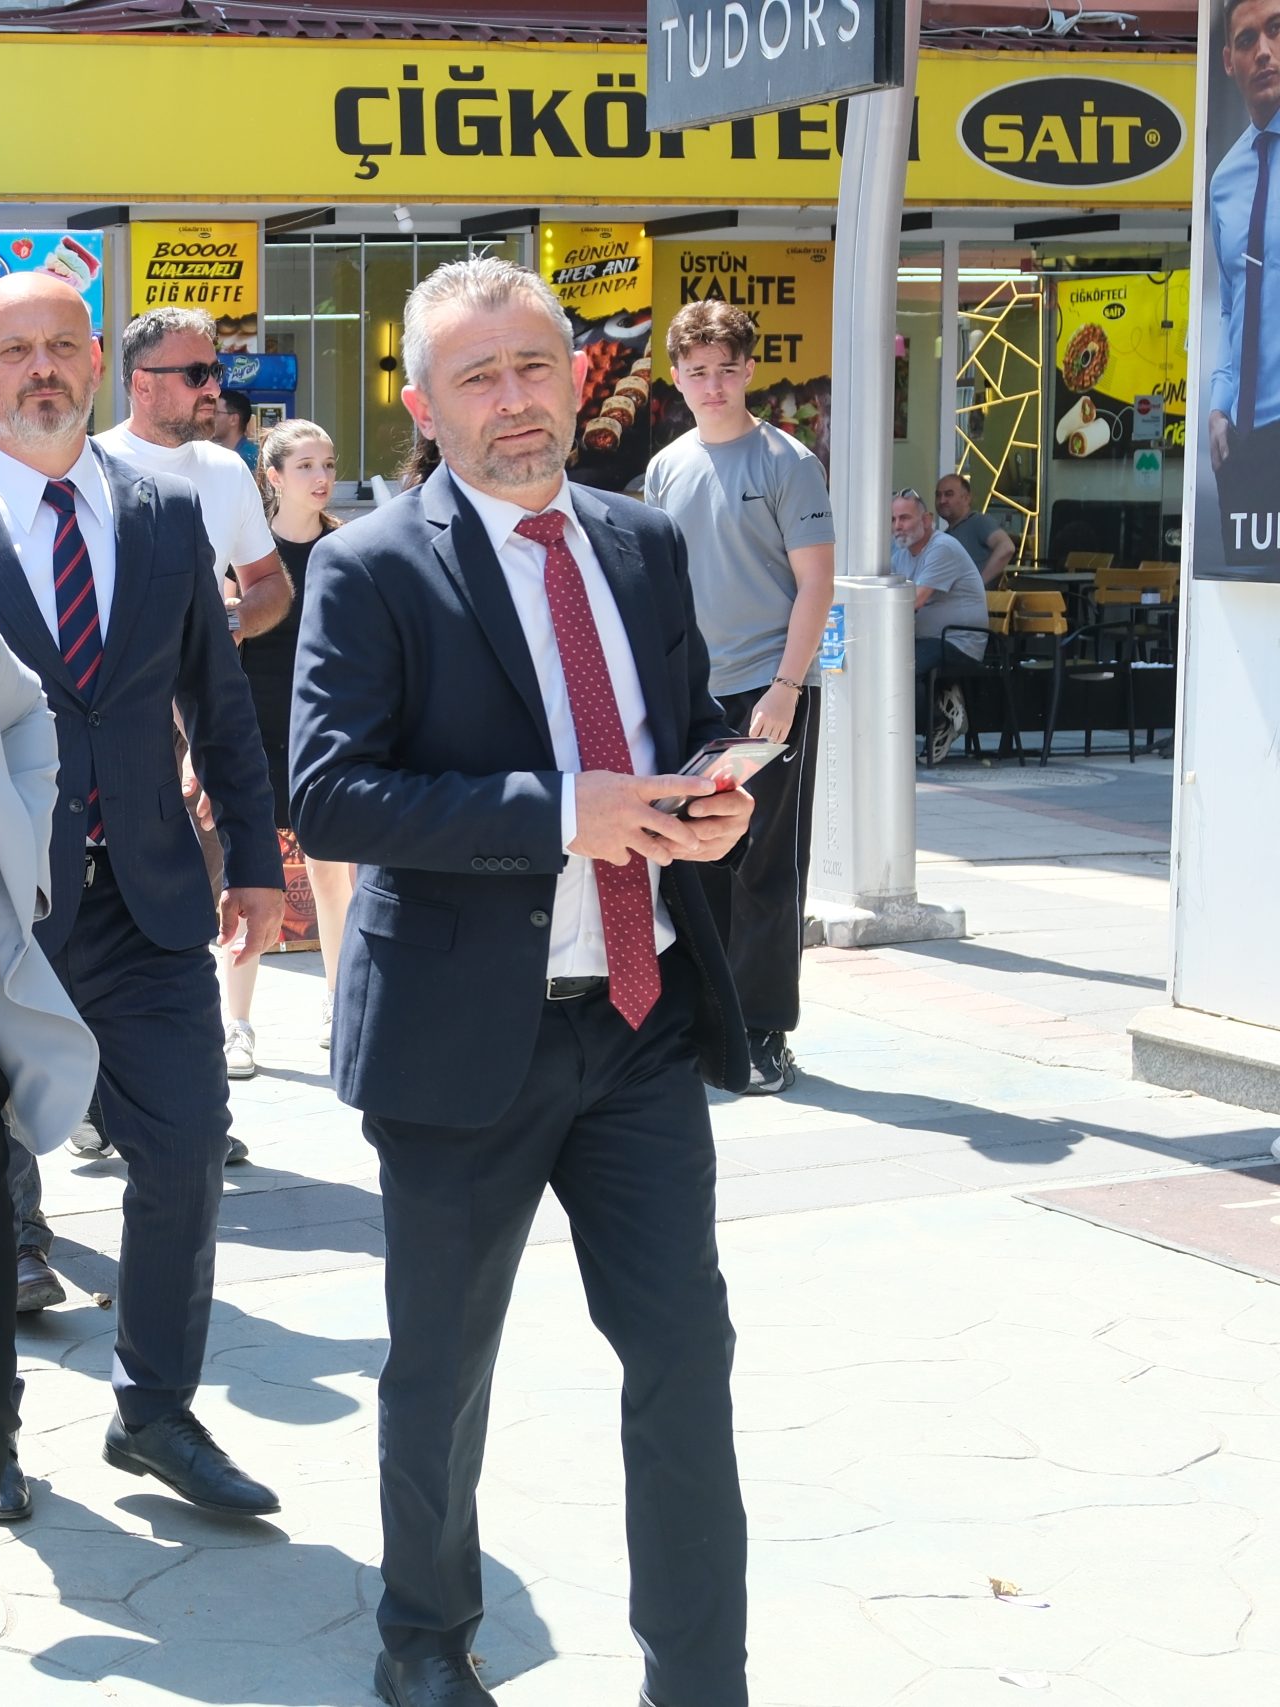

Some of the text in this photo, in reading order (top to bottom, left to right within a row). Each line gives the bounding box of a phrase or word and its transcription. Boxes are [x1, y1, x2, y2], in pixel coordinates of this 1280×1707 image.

[660, 0, 860, 82] TUDORS
[984, 100, 1141, 163] SAİT
[153, 242, 238, 258] BOOOOL
[564, 241, 629, 264] GÜNÜN
[151, 262, 238, 278] MALZEMELİ
[557, 258, 635, 283] HER ANI
[680, 251, 747, 273] ÜSTÜN
[146, 282, 244, 304] ÇİĞ KÖFTE
[558, 276, 637, 300] AKLINDA
[1070, 285, 1127, 306] ÇİĞKÖFTECİ
[1230, 512, 1280, 550] TU
